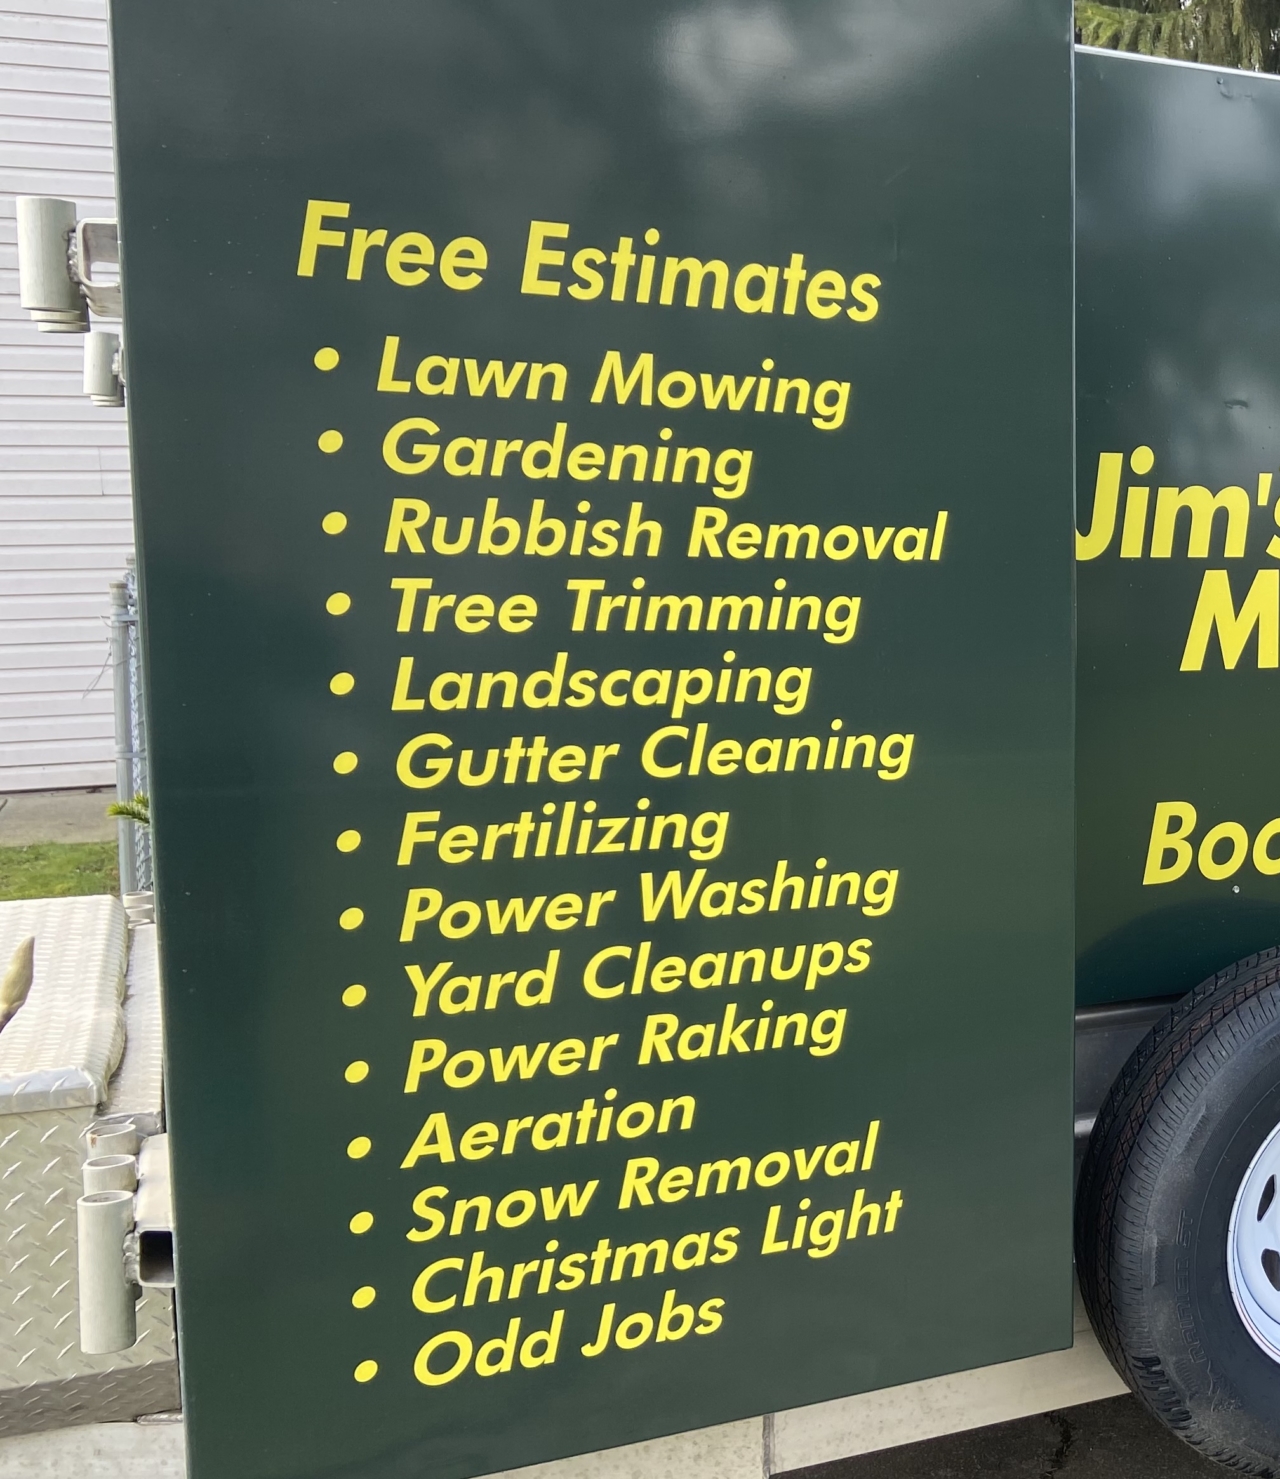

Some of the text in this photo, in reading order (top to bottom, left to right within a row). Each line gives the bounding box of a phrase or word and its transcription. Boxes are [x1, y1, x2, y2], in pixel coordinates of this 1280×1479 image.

[297, 199, 882, 324] Free Estimates
[377, 335, 852, 431] Lawn Mowing
[383, 417, 754, 501] Gardening
[384, 497, 949, 563] Rubbish Removal
[390, 577, 862, 646] Tree Trimming
[391, 651, 813, 720] Landscaping
[395, 722, 915, 791] Gutter Cleaning
[396, 797, 730, 867] Fertilizing
[399, 859, 900, 944] Power Washing
[404, 938, 873, 1018] Yard Cleanups
[403, 1002, 848, 1095] Power Raking
[400, 1087, 696, 1169] Aeration
[406, 1119, 881, 1244] Snow Removal
[411, 1188, 904, 1315] Christmas Light
[1175, 1208, 1194, 1248] ST
[413, 1288, 725, 1387] Odd Jobs
